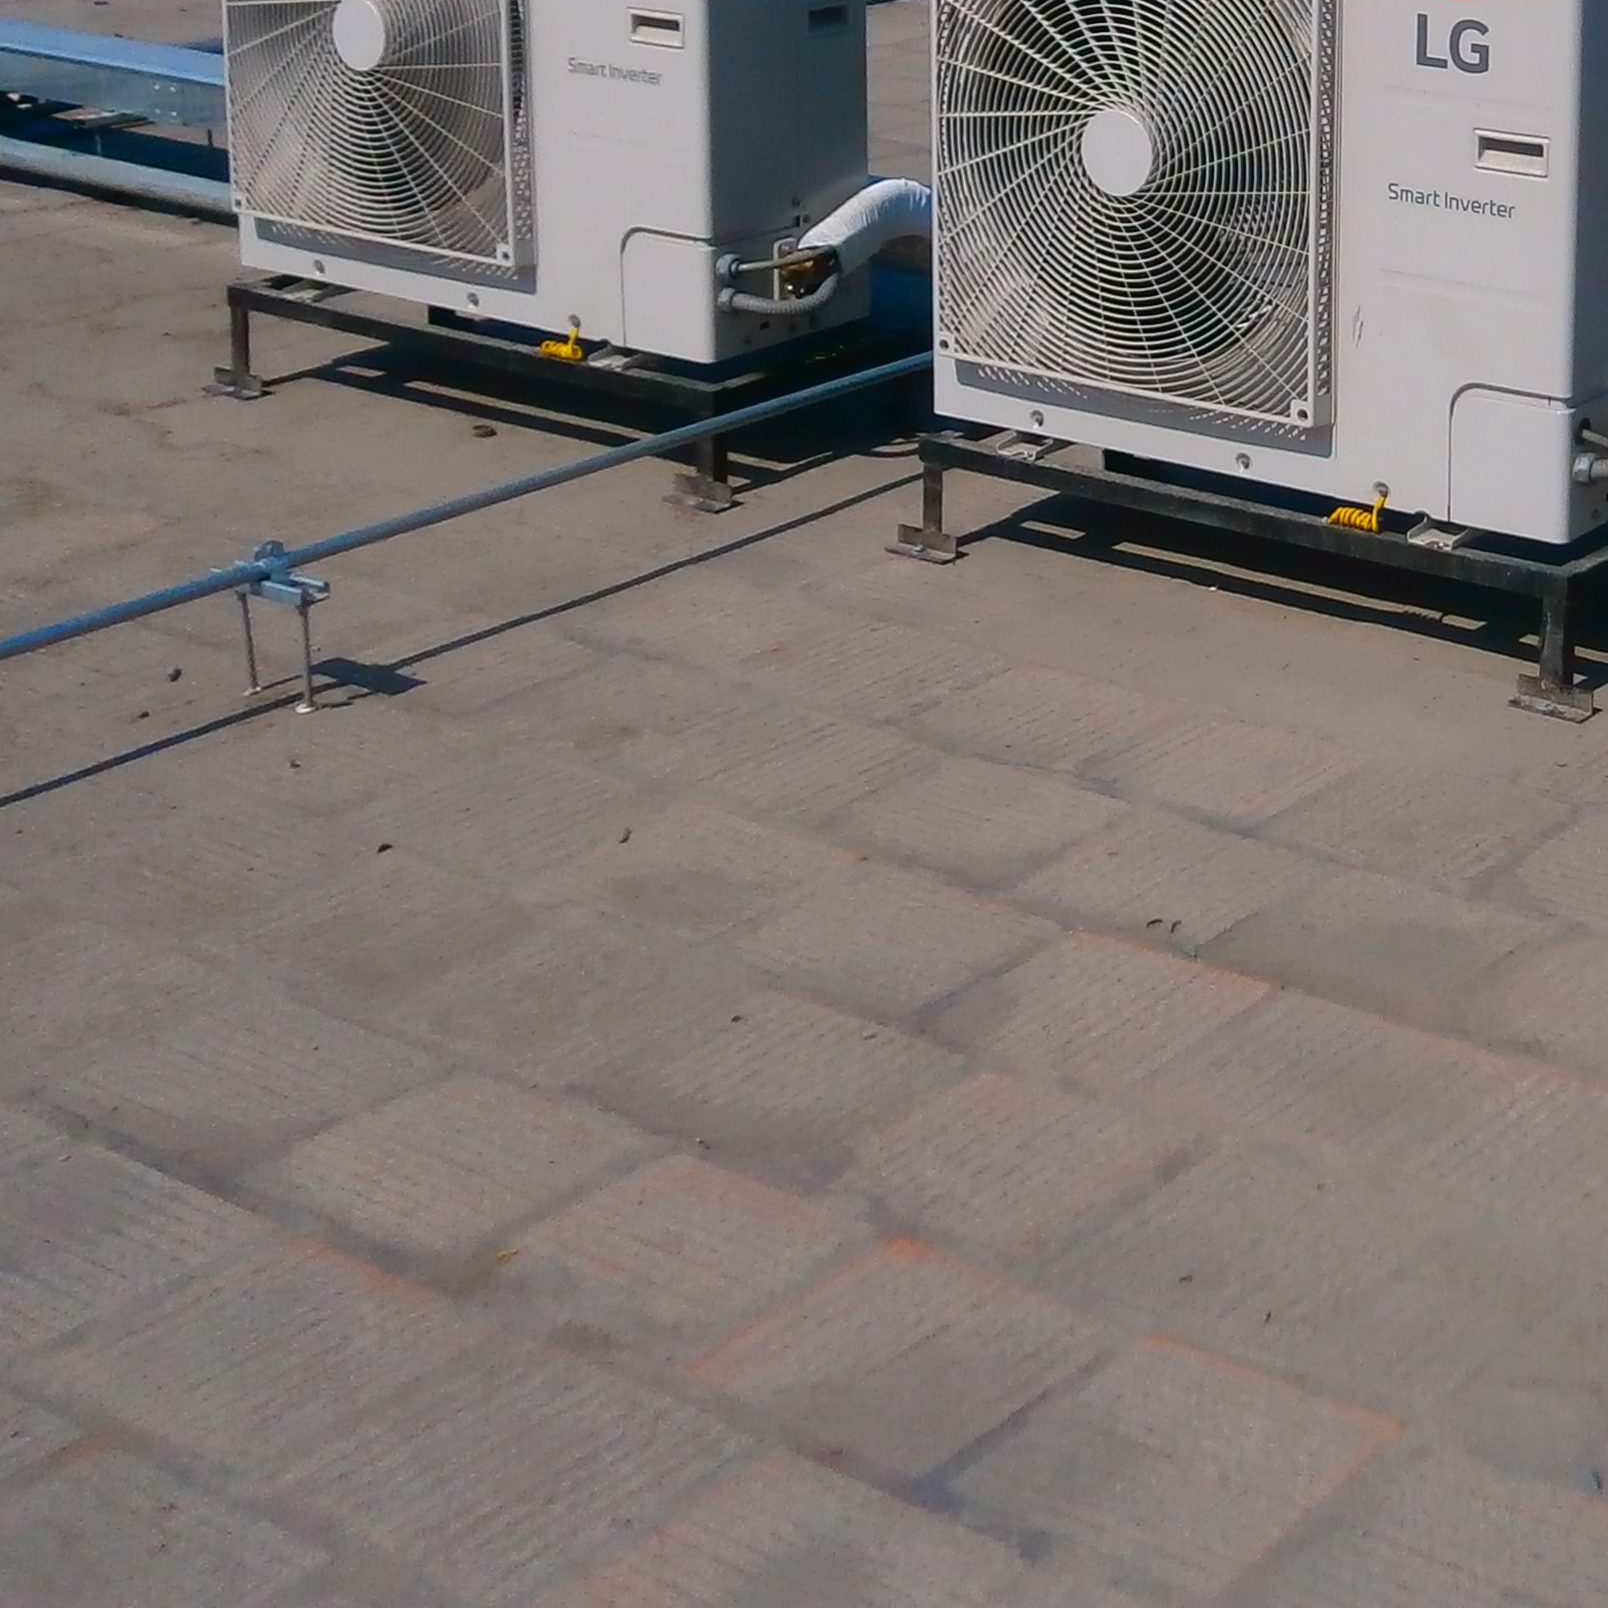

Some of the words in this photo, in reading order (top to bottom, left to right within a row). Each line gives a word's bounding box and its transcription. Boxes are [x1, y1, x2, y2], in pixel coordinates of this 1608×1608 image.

[1416, 14, 1490, 74] LG
[567, 57, 607, 78] Smart
[608, 63, 662, 86] Inverter
[1387, 182, 1441, 208] Smart
[1444, 191, 1516, 219] Inverter
